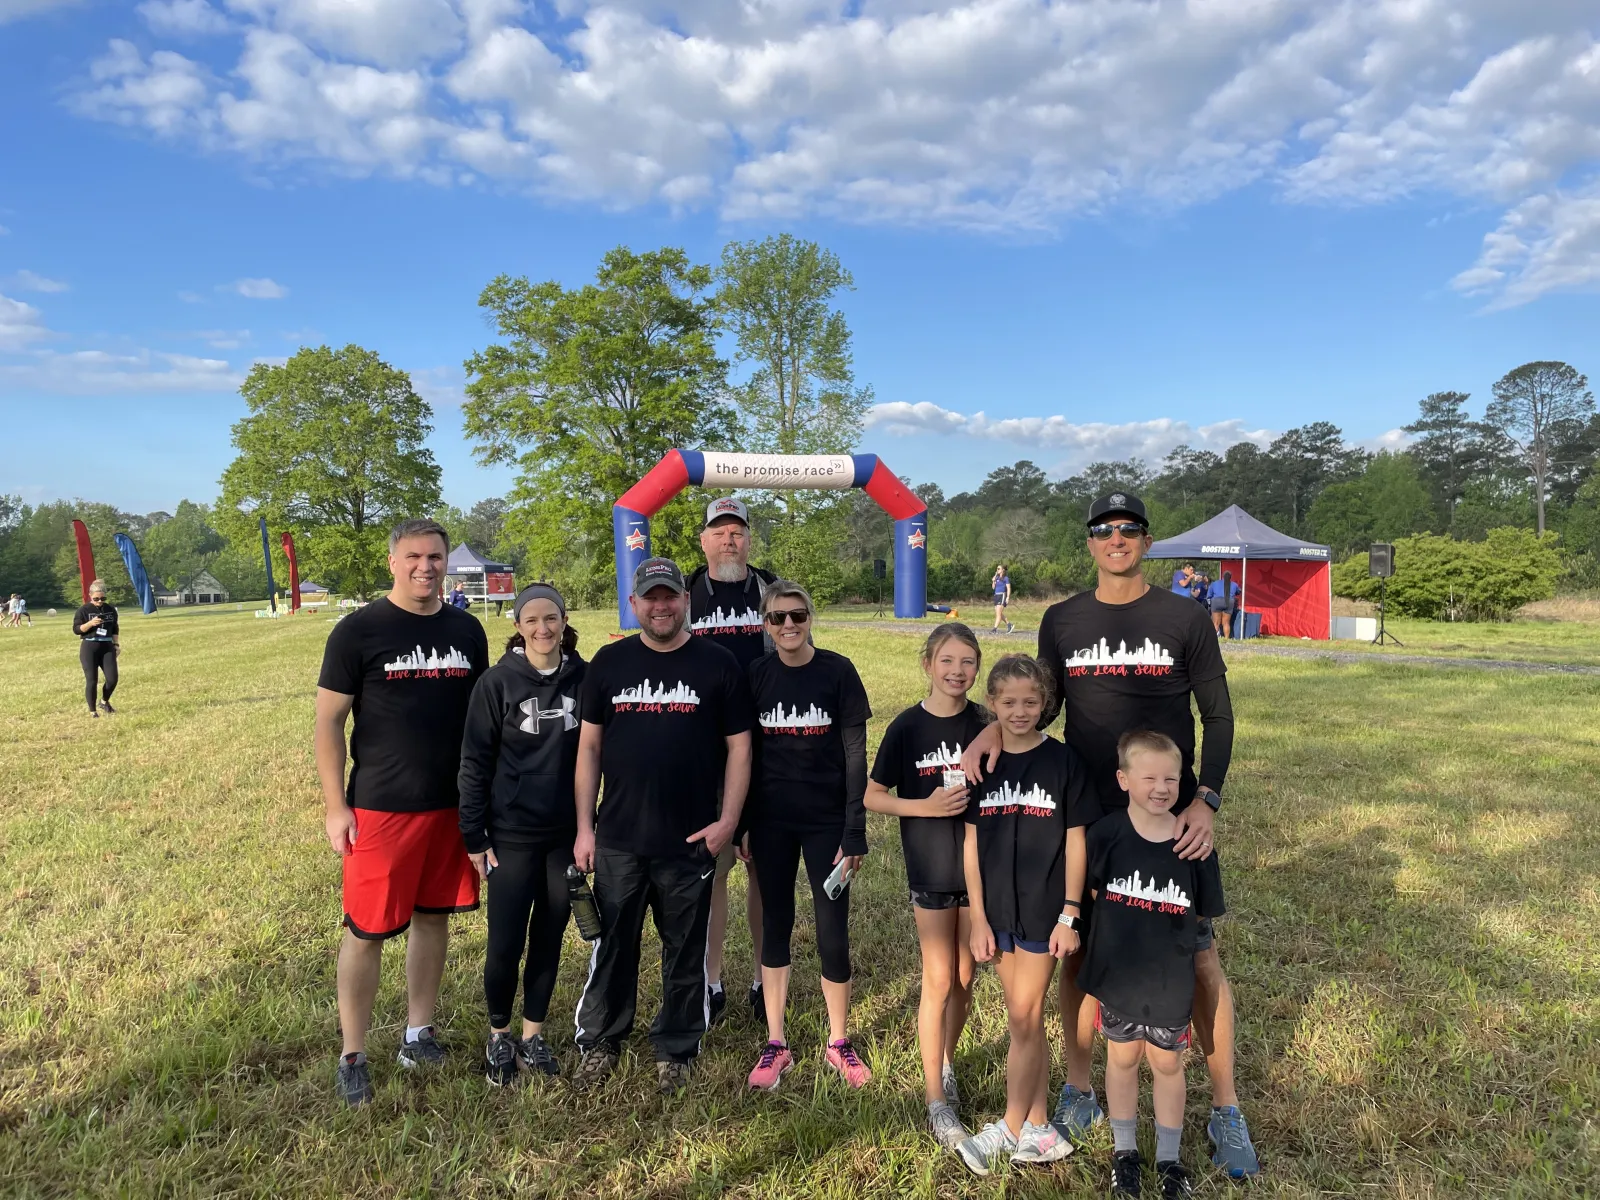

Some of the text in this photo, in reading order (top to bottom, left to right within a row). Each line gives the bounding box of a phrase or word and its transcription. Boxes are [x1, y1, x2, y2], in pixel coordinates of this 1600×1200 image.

[716, 463, 833, 477] the promise race
